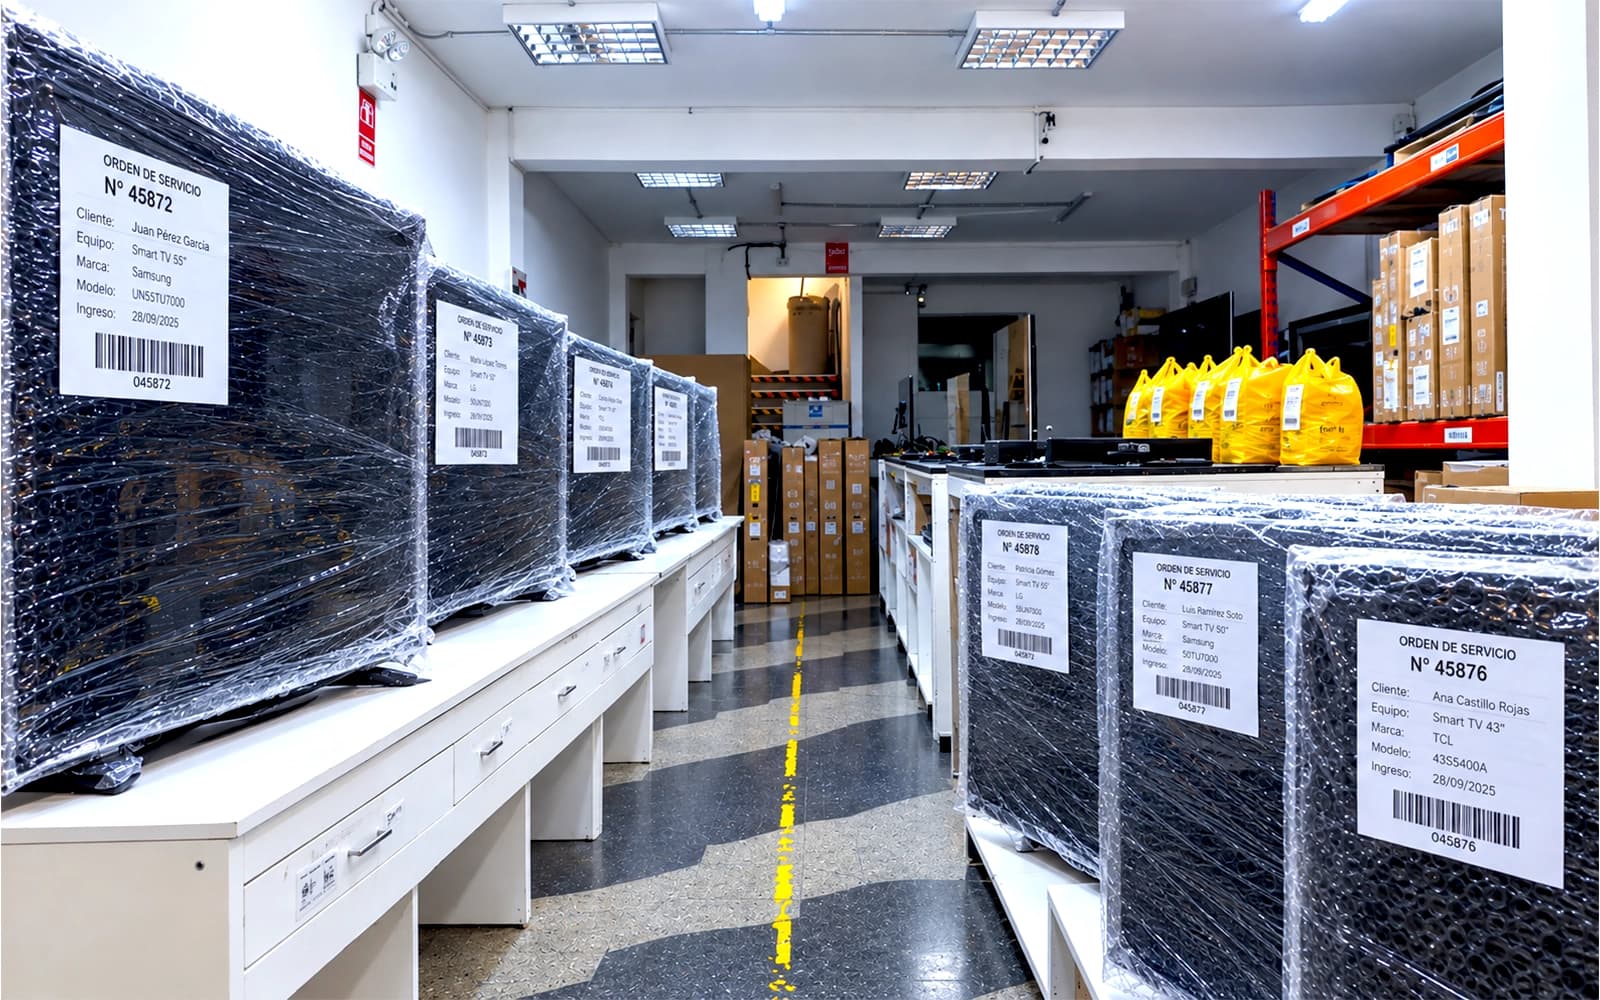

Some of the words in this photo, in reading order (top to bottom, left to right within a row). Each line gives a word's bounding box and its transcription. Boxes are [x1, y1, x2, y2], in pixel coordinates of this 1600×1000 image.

[103, 154, 140, 176] ORDEN
[143, 168, 156, 182] DE
[158, 173, 201, 197] SERVICIO
[129, 185, 173, 213] 45872
[76, 207, 115, 227] Cliente:
[132, 222, 154, 237] Juan
[76, 231, 114, 251] Equipo:
[132, 244, 158, 260] Smart
[160, 251, 171, 263] TV
[76, 255, 110, 272] Marca:
[132, 266, 172, 287] Samsung
[76, 279, 116, 296] Modelo:
[76, 302, 116, 319] Ingreso:
[132, 311, 179, 328] 28/09/2025
[473, 334, 493, 348] 45873
[133, 376, 171, 389] 045872
[1015, 542, 1040, 555] 45878
[1156, 563, 1182, 572] ORDEN
[1184, 566, 1194, 575] DE
[1195, 567, 1231, 578] SERVICIO
[1180, 580, 1212, 595] 45877
[1182, 605, 1196, 614] Luis
[1226, 610, 1243, 620] Soto
[1182, 621, 1204, 630] Smart
[1205, 624, 1215, 632] TV
[1182, 635, 1215, 649] Samsung
[1399, 635, 1439, 651] ORDEN
[1442, 642, 1458, 653] DE
[1460, 644, 1517, 661] SERVICIO
[1182, 650, 1219, 663] 50TU7000
[1435, 659, 1488, 682] 45876
[1371, 682, 1410, 698] Cliente:
[1432, 692, 1454, 705] Ana
[1456, 694, 1496, 711] Castillo
[1499, 701, 1531, 717] Rojas
[1371, 702, 1409, 719] Equipo:
[1433, 712, 1465, 728] Smart
[1468, 718, 1483, 730] TV
[1485, 721, 1506, 733] 43"
[1371, 722, 1405, 737] Marca:
[1433, 733, 1454, 746] TCL
[1371, 742, 1412, 759] Modelo:
[1433, 754, 1488, 774] 43S5400A
[1371, 761, 1412, 779] Ingreso:
[1433, 774, 1496, 797] 28/09/2025
[1431, 832, 1477, 853] 045876
